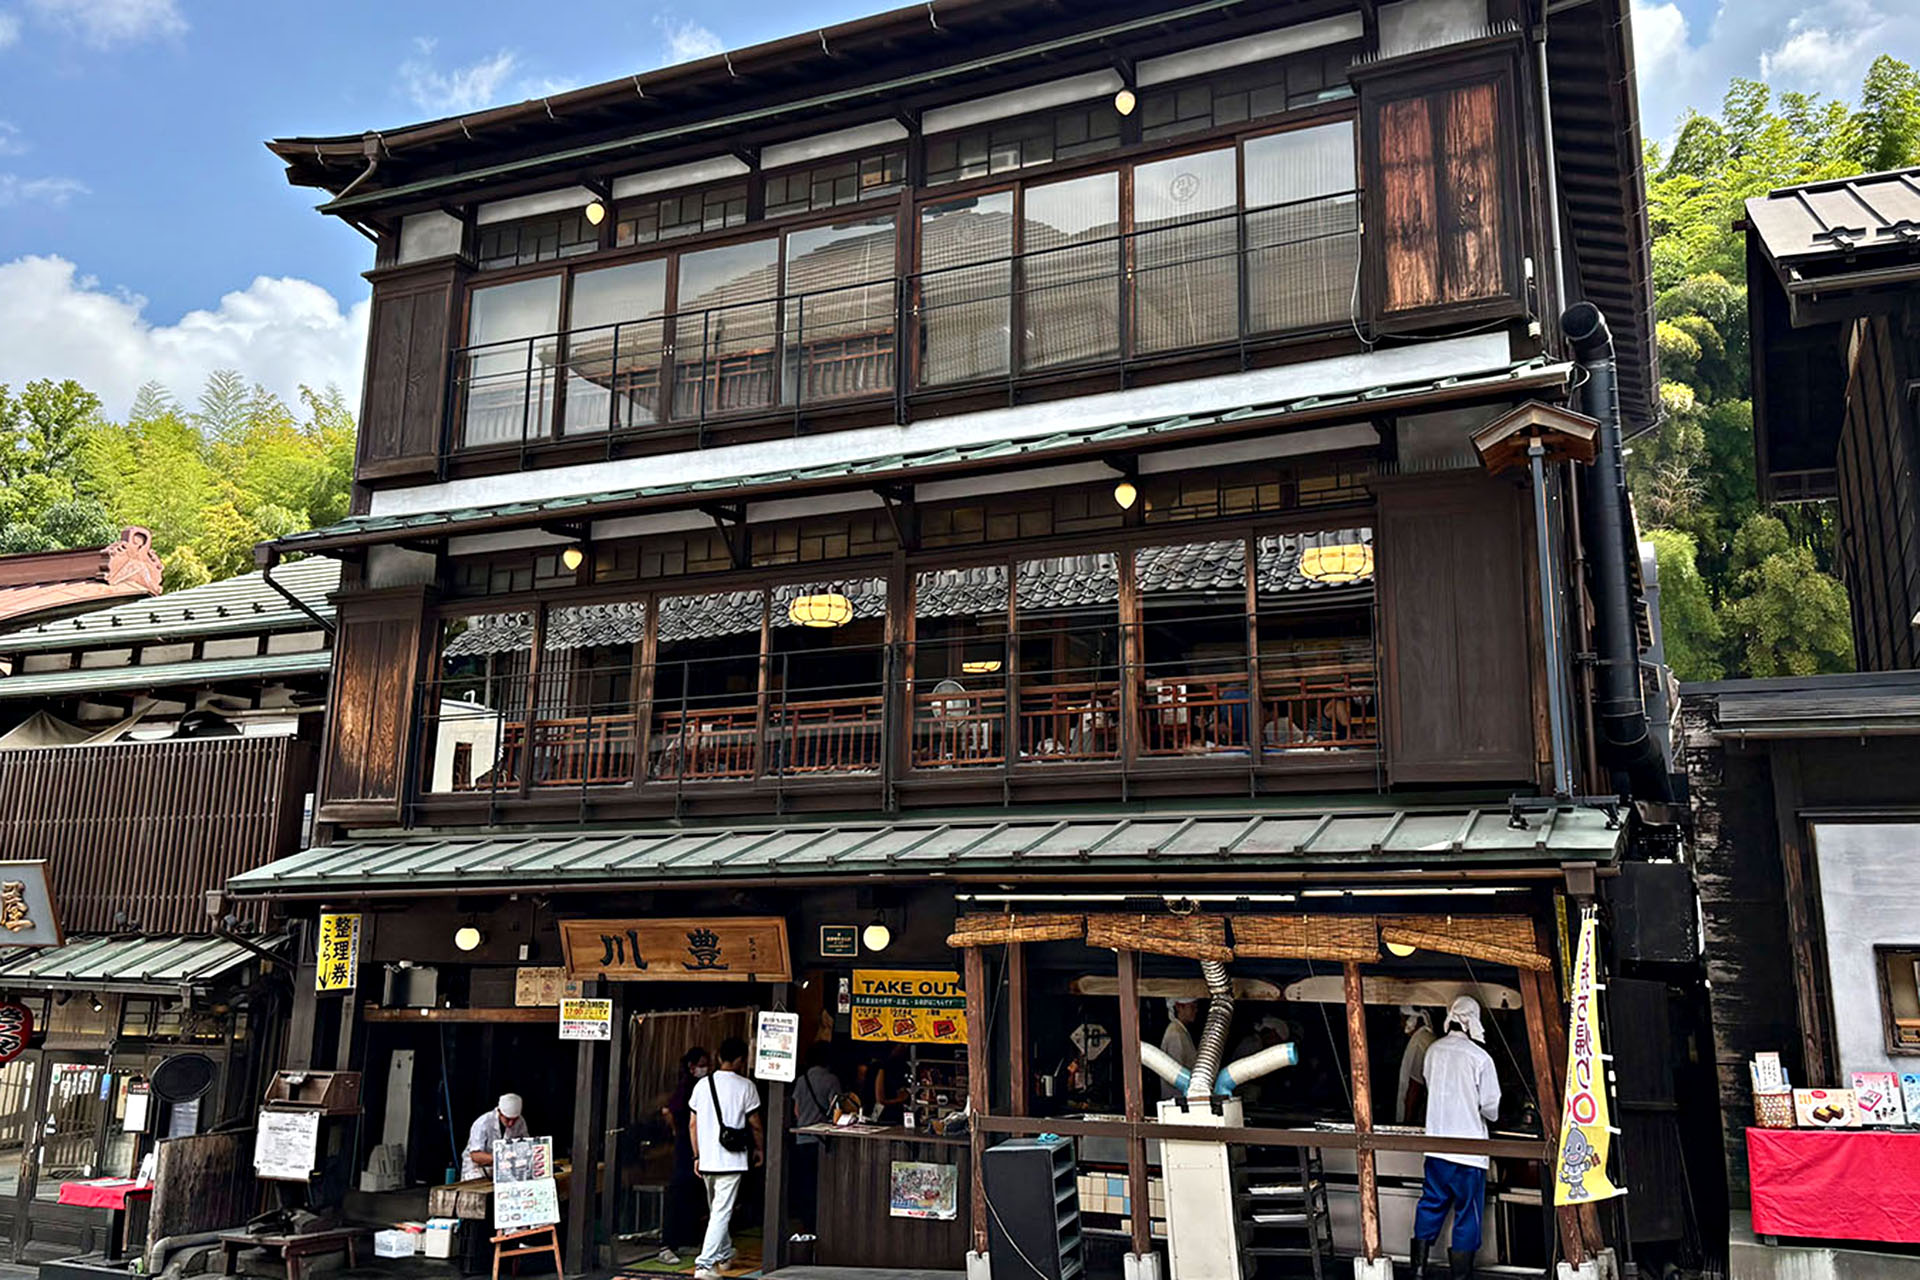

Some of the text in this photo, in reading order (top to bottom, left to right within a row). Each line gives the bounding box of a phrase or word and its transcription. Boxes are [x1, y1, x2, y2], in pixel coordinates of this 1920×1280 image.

[322, 920, 332, 962] こちら
[332, 916, 351, 985] 整理券
[600, 928, 729, 971] 川豊
[862, 981, 958, 995] TAKE OUT
